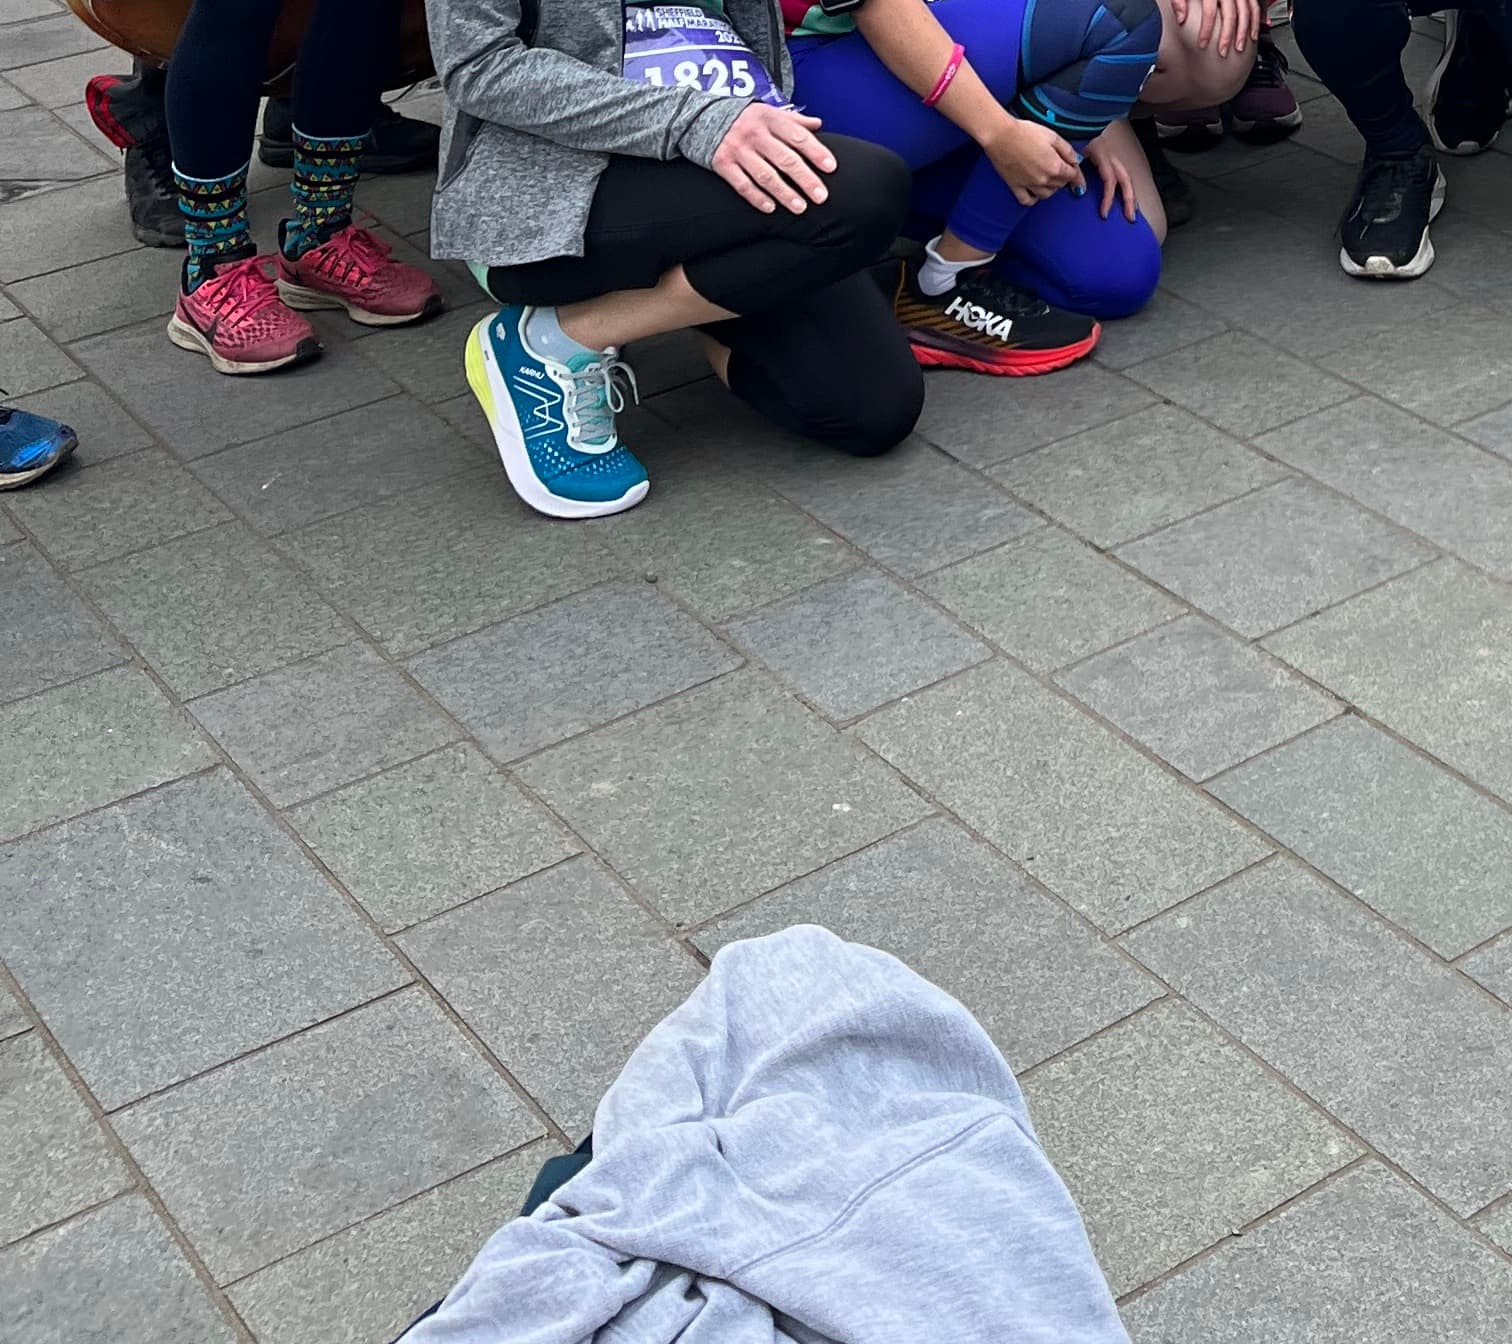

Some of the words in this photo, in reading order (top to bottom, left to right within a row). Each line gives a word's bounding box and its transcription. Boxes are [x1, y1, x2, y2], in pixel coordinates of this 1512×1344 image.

[657, 17, 685, 29] HALF
[644, 59, 756, 97] 1825
[944, 295, 1013, 342] HOKA
